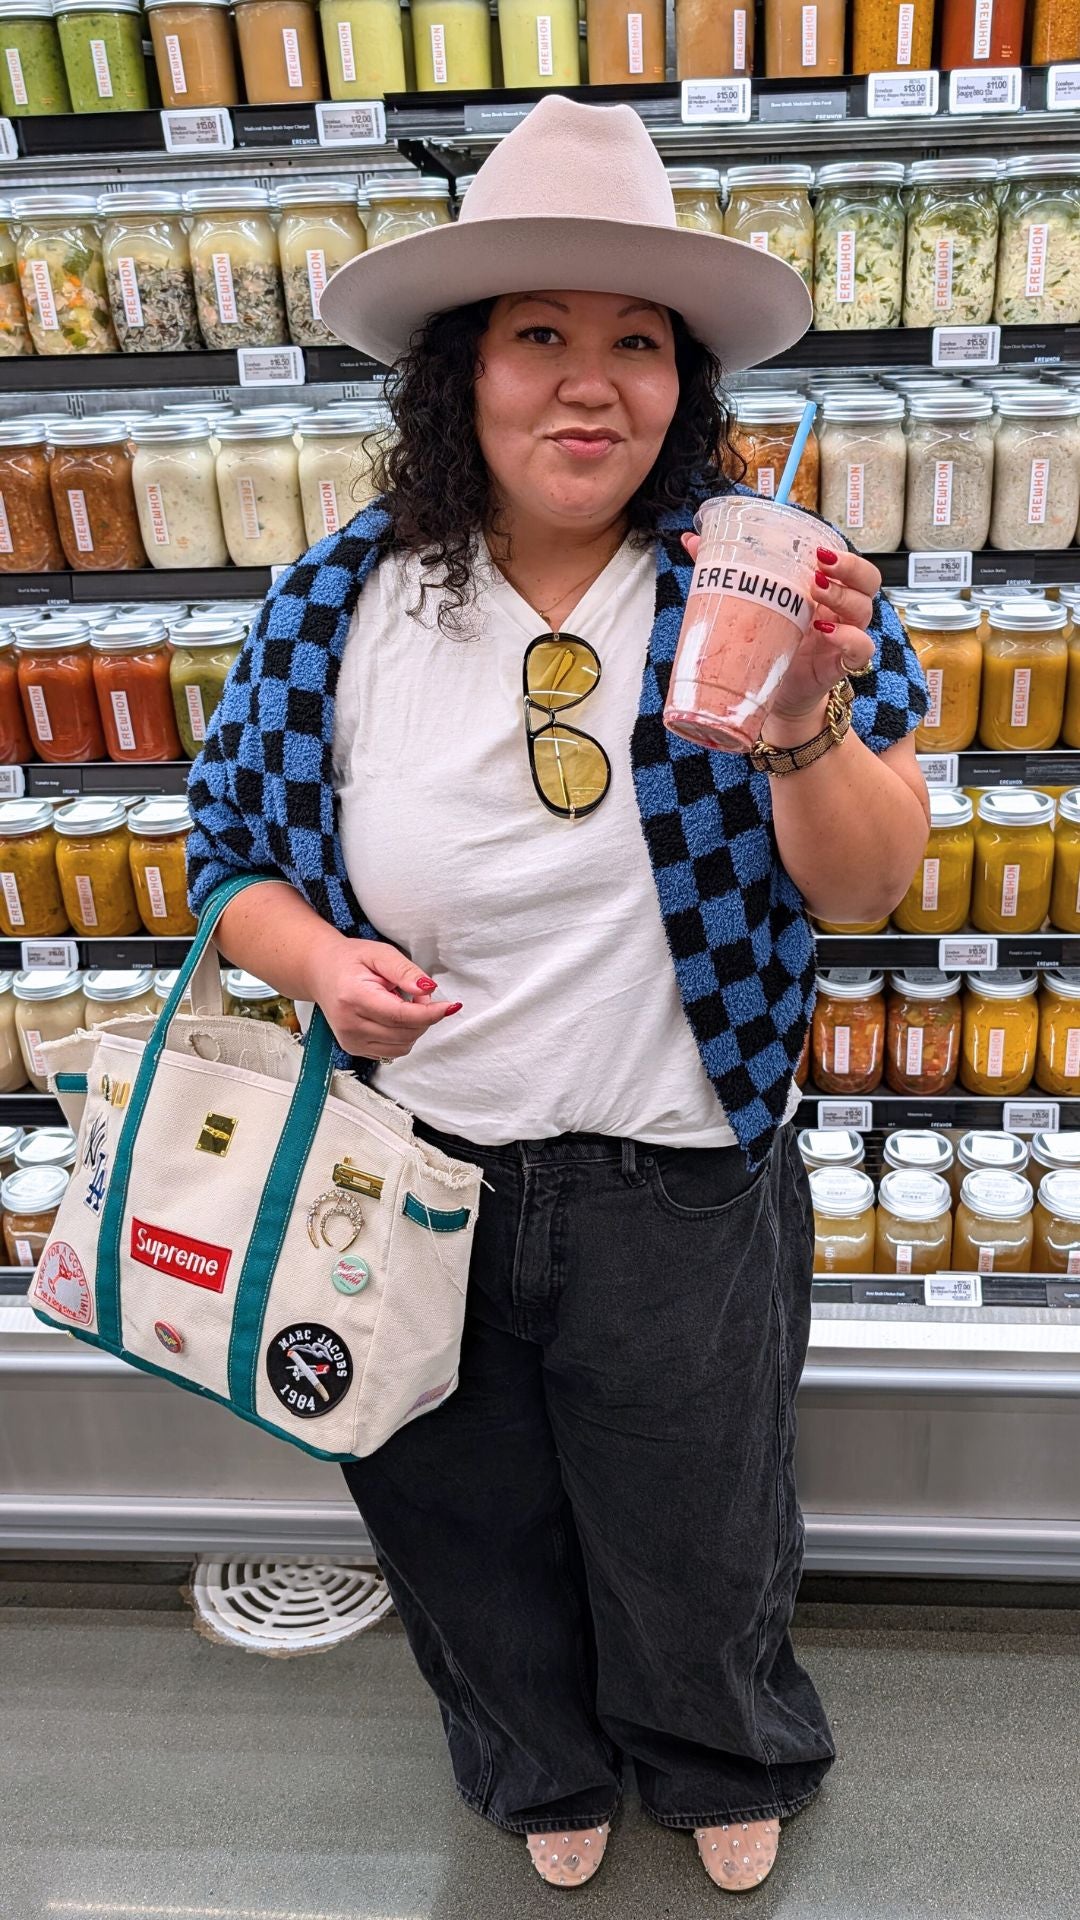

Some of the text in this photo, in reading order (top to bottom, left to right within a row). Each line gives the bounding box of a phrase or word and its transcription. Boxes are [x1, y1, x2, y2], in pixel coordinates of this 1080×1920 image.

[978, 0, 990, 55] REWHON
[215, 256, 235, 320] EREWHON
[310, 252, 324, 316] WHON
[841, 234, 851, 300] EREWHON
[938, 241, 950, 307] EREWHON
[1030, 227, 1044, 294] EREWHON
[34, 264, 54, 328] EREWHON
[121, 260, 140, 323] EREWHON
[147, 486, 166, 542] EREWHON
[240, 480, 257, 537] EREWHON
[321, 483, 337, 532] REWHON
[850, 467, 861, 525] EREWHON
[936, 464, 949, 523] EREWHON
[1032, 462, 1045, 521] EREWHON
[71, 493, 89, 549] EREWHON
[697, 567, 804, 616] EREWHON
[31, 688, 50, 739] EREWHON
[113, 694, 132, 748] EREWHON
[187, 687, 204, 739] EREWHON
[1015, 671, 1028, 725] EREWHON
[3, 875, 21, 923] EREWHON
[77, 877, 95, 924] EREWHON
[147, 869, 164, 916] EREWHON
[925, 860, 937, 908] EREWHON
[1004, 865, 1016, 914] EREWHON
[136, 1227, 219, 1277] Supreme
[69, 1253, 85, 1286] GOOD
[79, 1293, 89, 1318] TIME
[278, 1330, 348, 1377] MARC JACOBS
[280, 1384, 316, 1411] 1984
